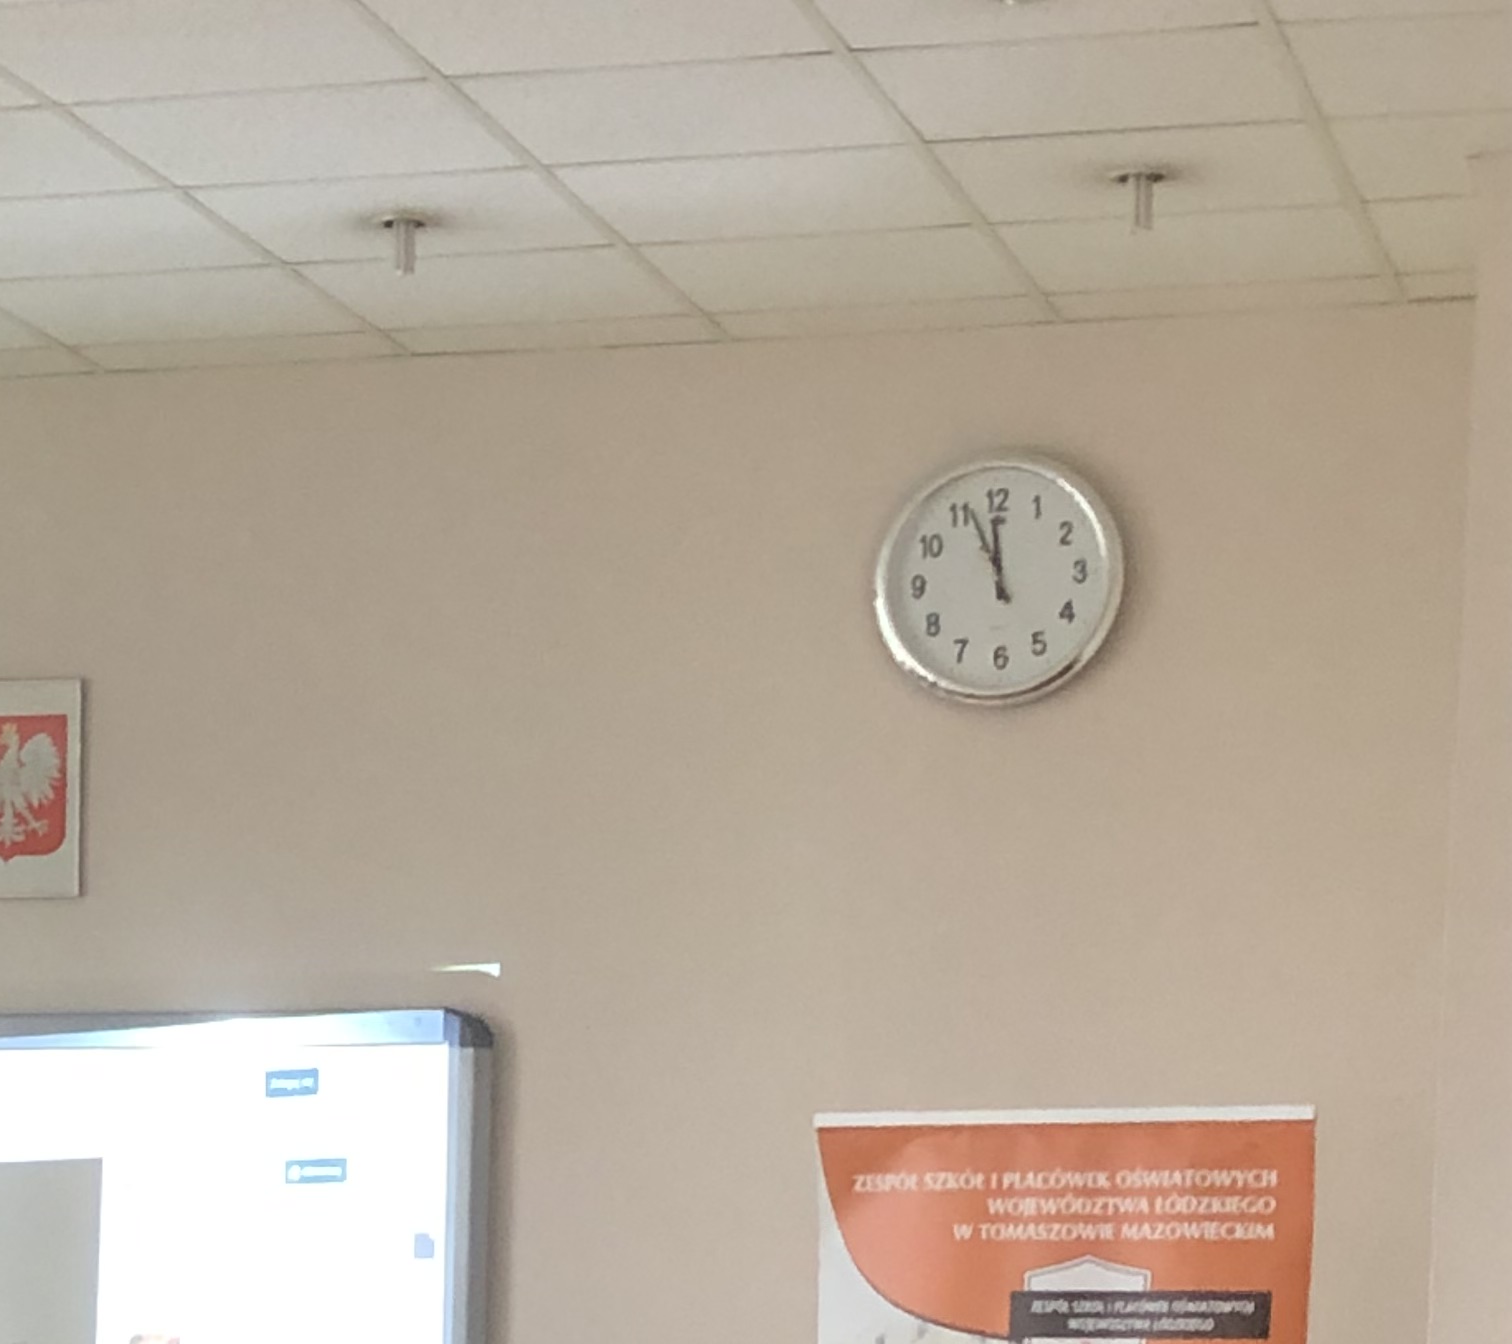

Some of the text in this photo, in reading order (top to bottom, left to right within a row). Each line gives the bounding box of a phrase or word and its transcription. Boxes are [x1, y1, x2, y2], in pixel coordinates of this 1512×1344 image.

[986, 487, 1010, 514] 12
[1031, 494, 1043, 520] 1
[949, 501, 971, 529] 11
[919, 533, 944, 559] 10
[1058, 520, 1074, 547] 2
[1072, 558, 1088, 585] 3
[910, 573, 927, 600] 9
[1058, 599, 1076, 624] 4
[925, 612, 941, 638] 8
[952, 637, 970, 664] 7
[1030, 630, 1048, 657] 5
[992, 645, 1010, 671] 6
[852, 1167, 1278, 1193] ZESPÓŁ SZKÓŁ I PLACÓWEK OŚWIATOWYCH
[987, 1192, 1277, 1217] WOJEWÓDZTWA ŁÓDZKIEGO
[952, 1220, 1275, 1241] W TOMASZOWIE MAZOWIECKIM
